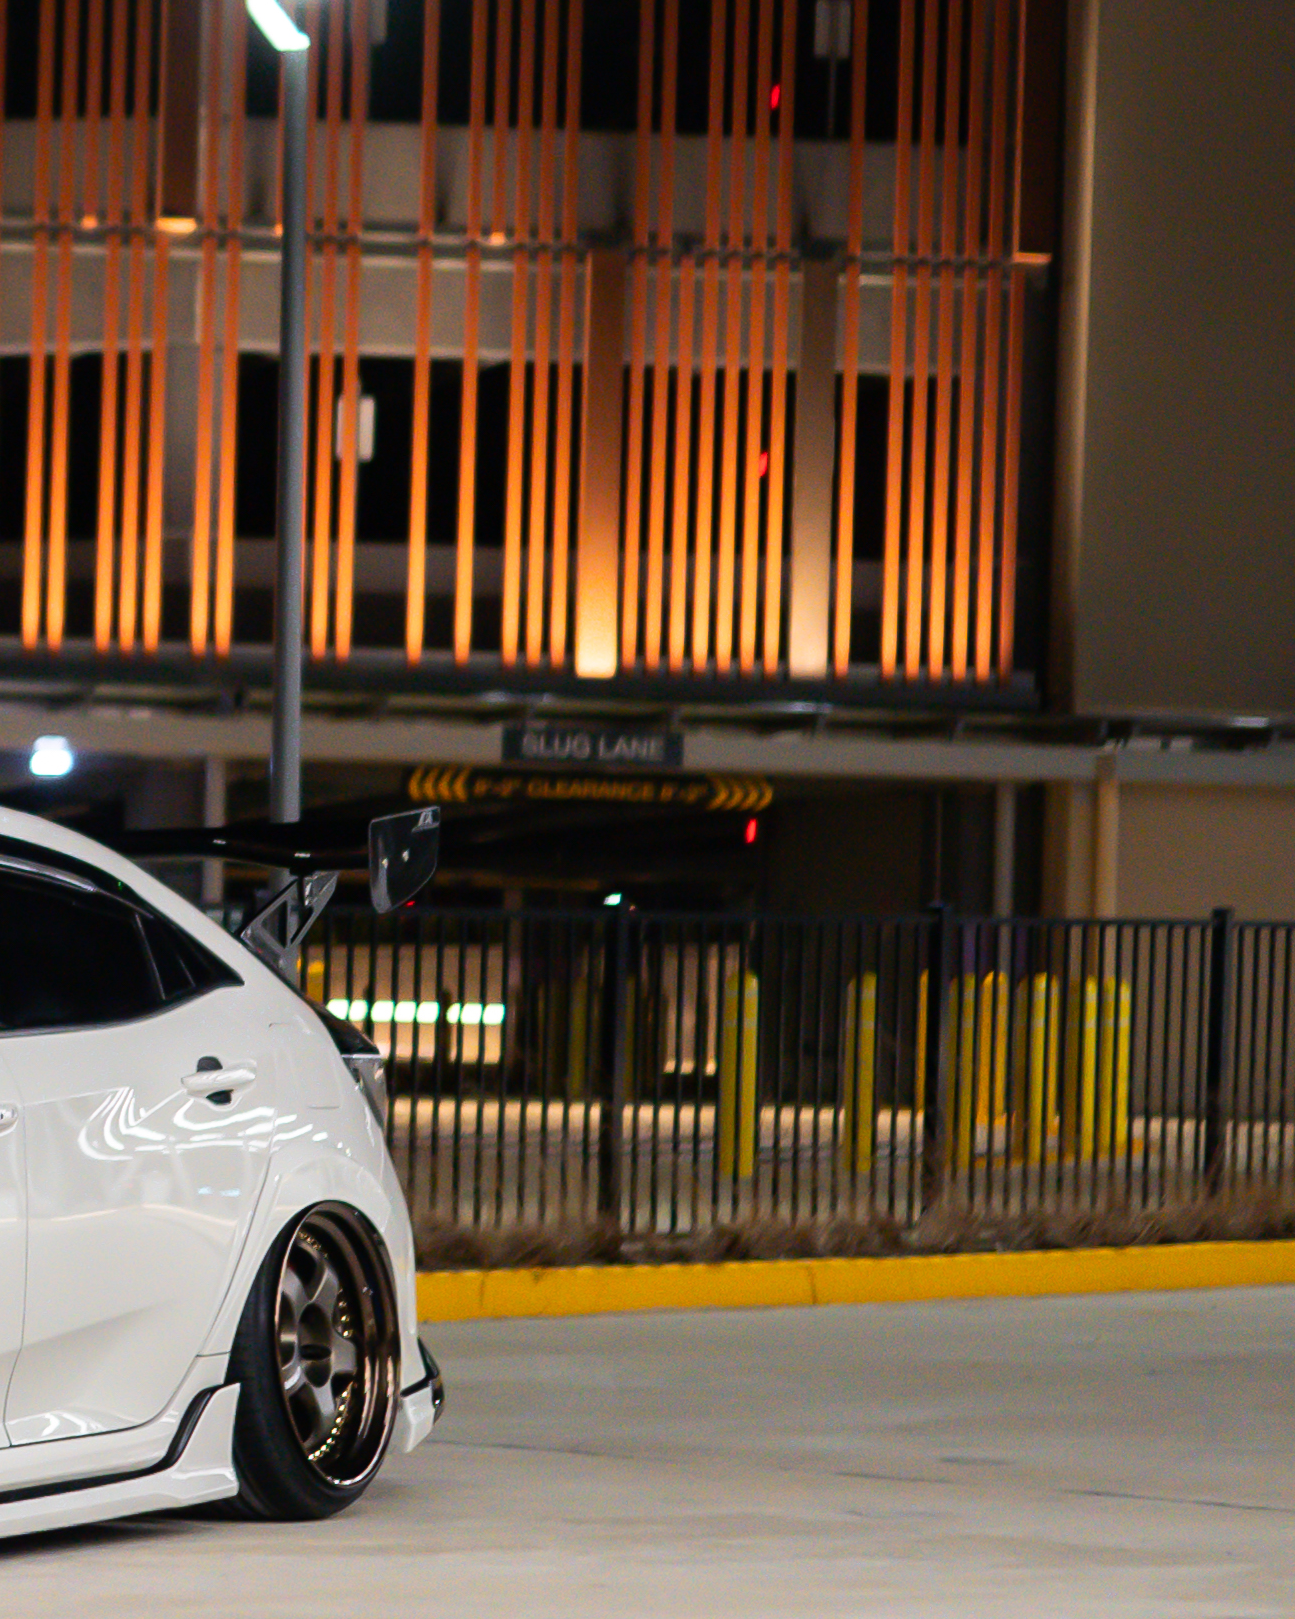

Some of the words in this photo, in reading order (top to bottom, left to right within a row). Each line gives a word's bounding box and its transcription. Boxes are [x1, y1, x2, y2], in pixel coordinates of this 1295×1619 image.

[522, 732, 591, 760] SLUG
[598, 735, 665, 762] LANE
[527, 779, 655, 802] CLEARANCE
